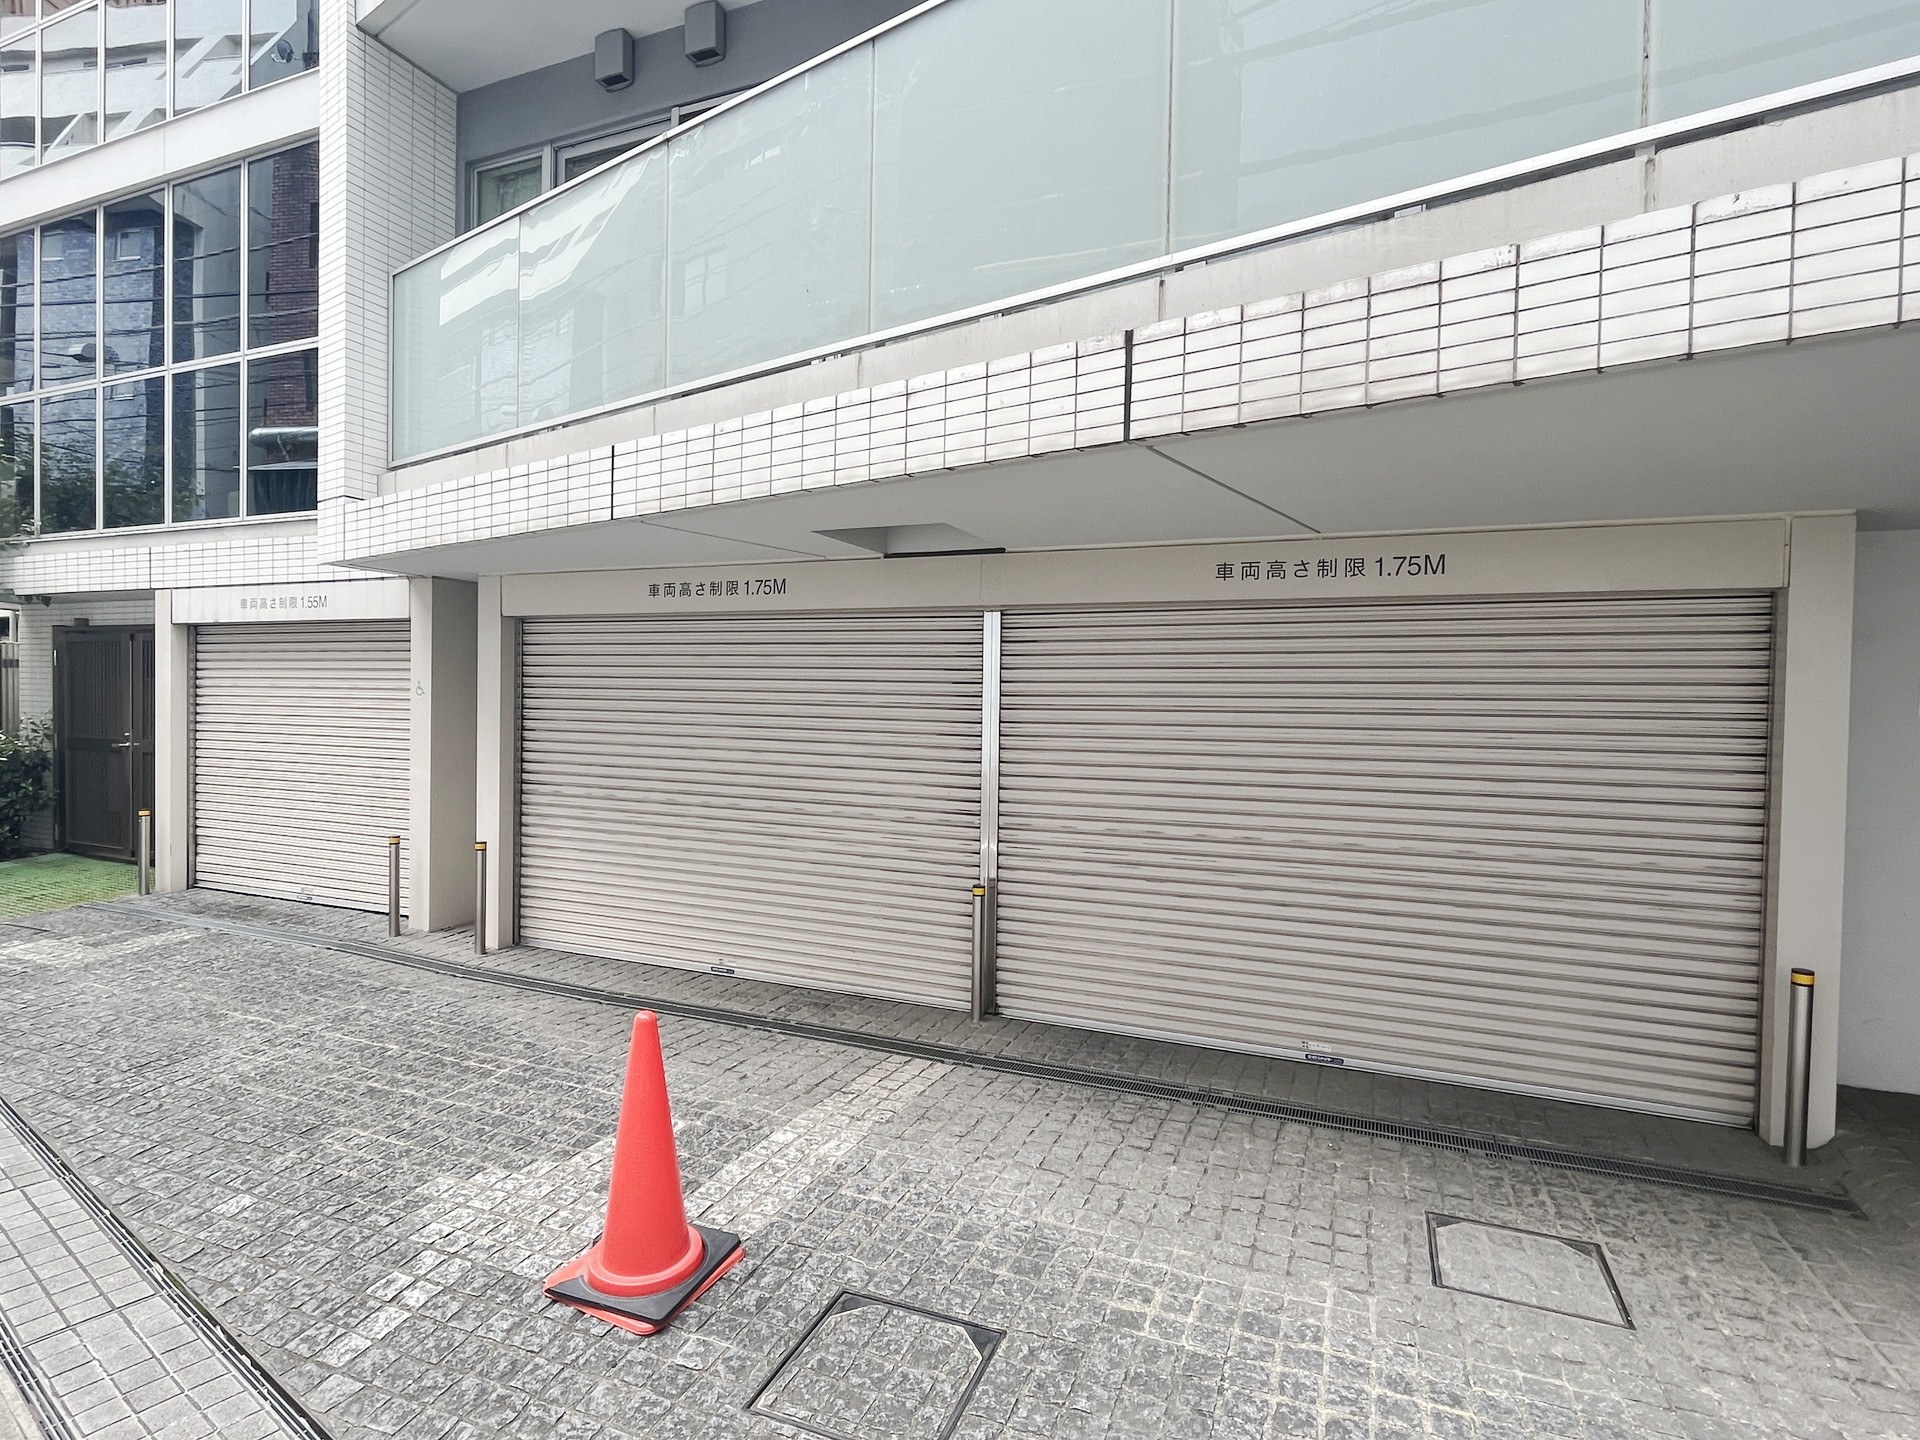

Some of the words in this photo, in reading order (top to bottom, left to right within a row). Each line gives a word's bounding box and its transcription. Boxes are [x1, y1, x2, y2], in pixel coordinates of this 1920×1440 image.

[1215, 558, 1366, 581] 車両高さ制限
[1375, 553, 1446, 577] 1.75M
[648, 581, 739, 598] 車両高さ制限
[744, 578, 787, 596] 1.75M
[240, 596, 298, 610] 車両高さ制限
[300, 595, 328, 609] 1.55M
